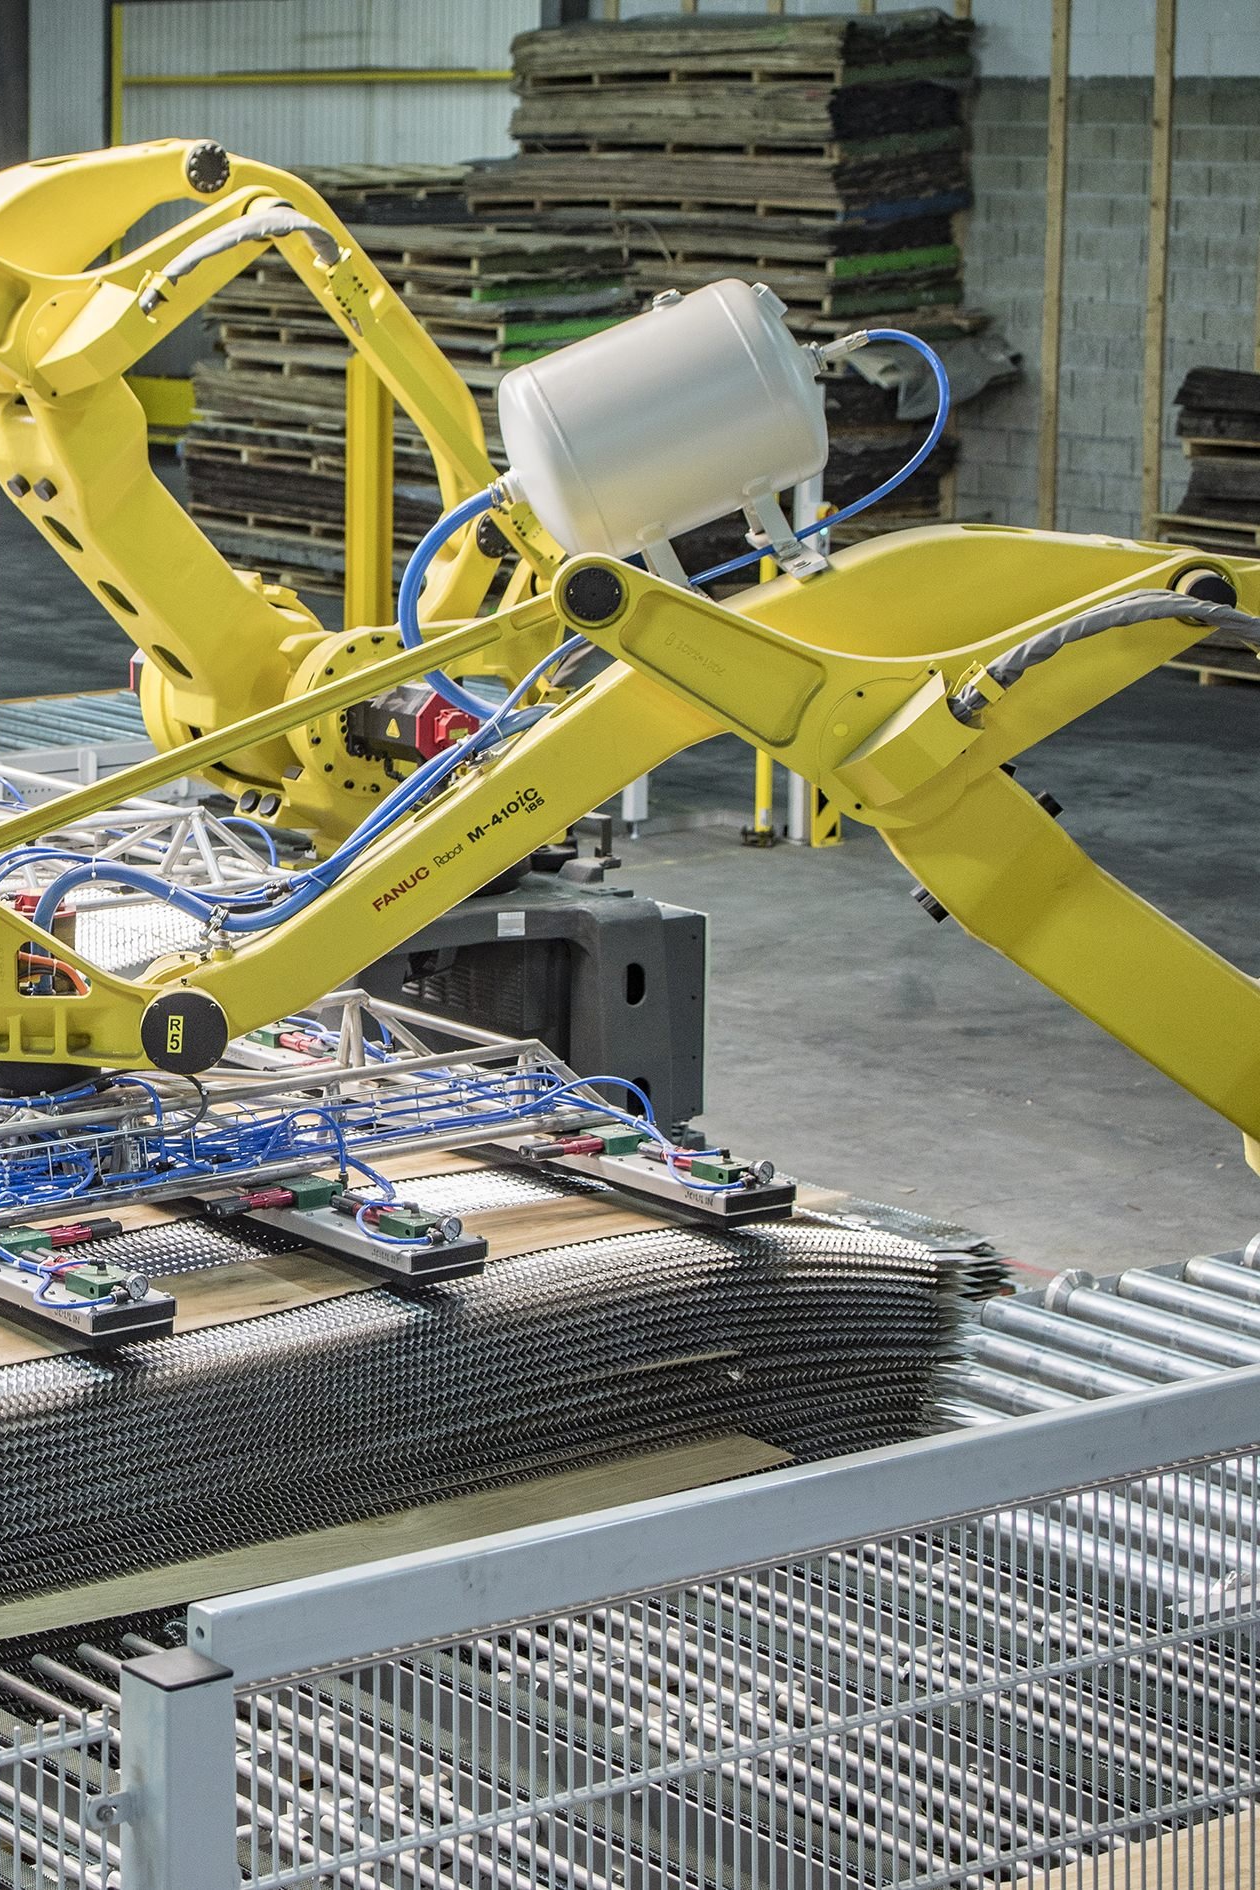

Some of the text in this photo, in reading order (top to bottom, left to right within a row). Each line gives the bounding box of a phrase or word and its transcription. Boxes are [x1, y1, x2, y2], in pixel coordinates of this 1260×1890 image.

[524, 797, 546, 814] 185
[372, 866, 431, 912] FANUC
[433, 843, 465, 868] Robot
[169, 1018, 181, 1032] R
[169, 1033, 180, 1051] 5
